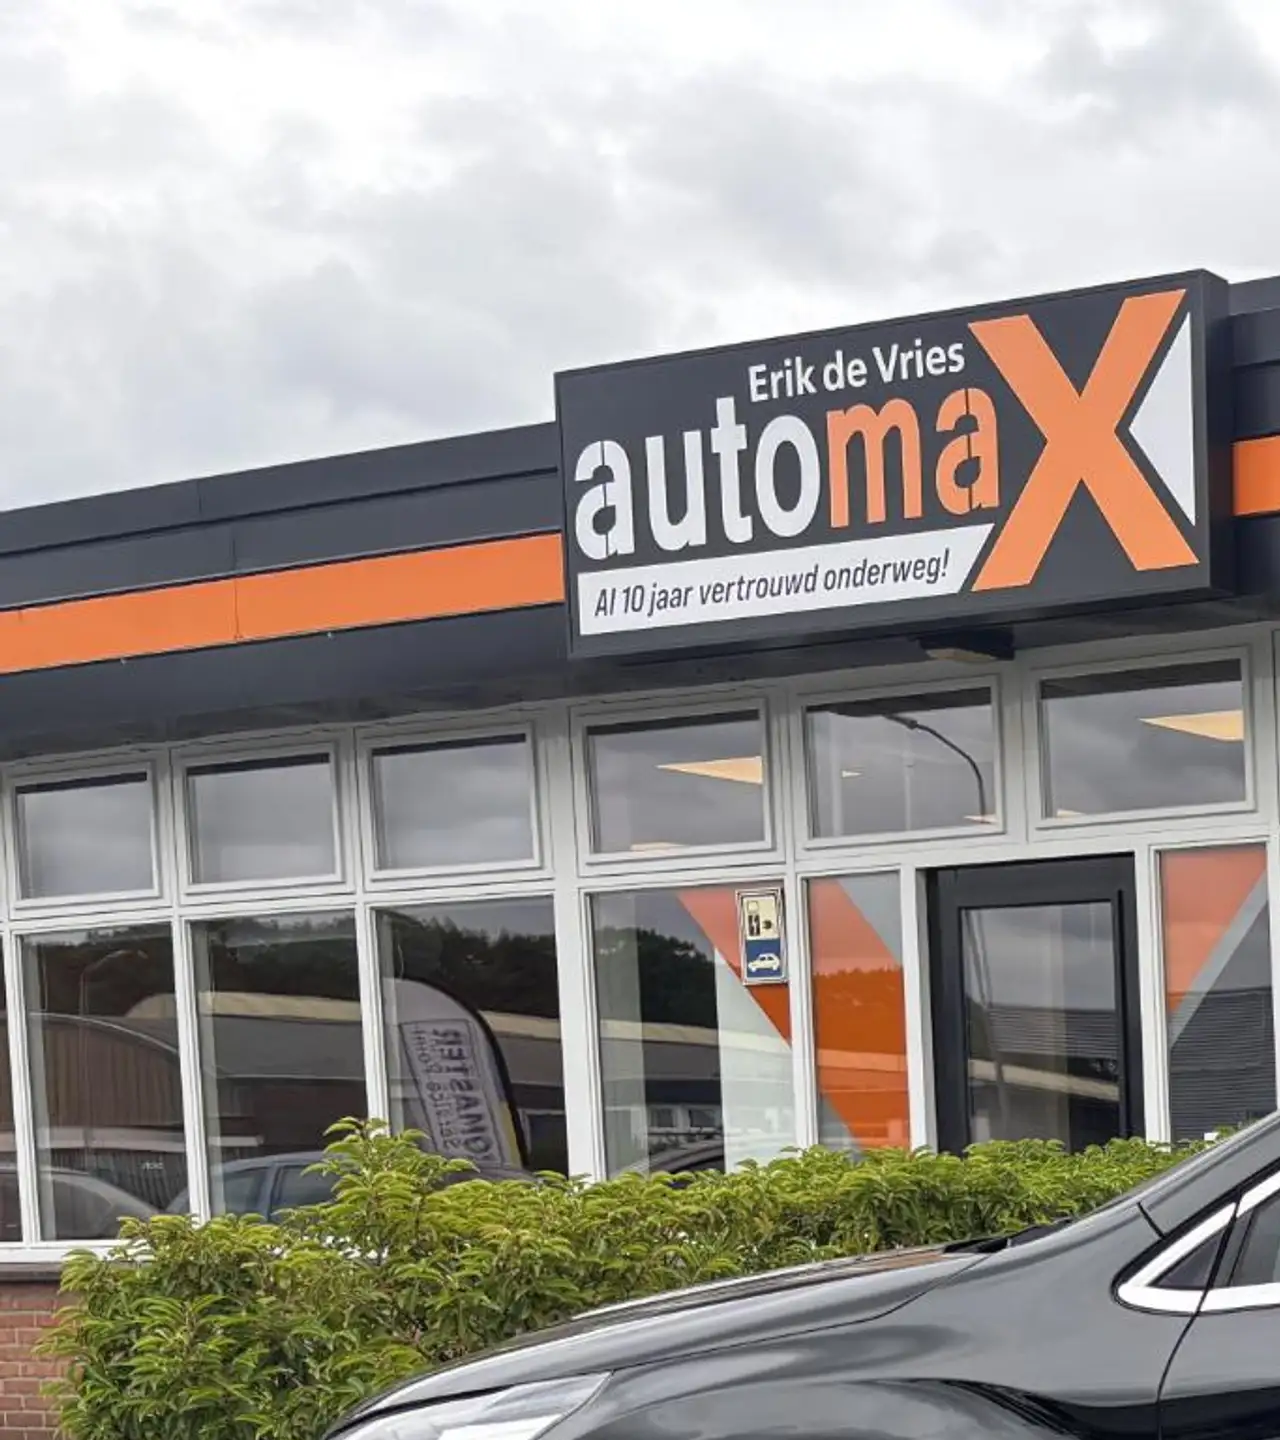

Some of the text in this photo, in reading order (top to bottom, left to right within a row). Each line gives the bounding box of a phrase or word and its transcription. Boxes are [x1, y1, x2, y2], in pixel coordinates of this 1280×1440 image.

[748, 338, 965, 402] Erik de Vries
[594, 547, 950, 617] Al 10 jaar vertrouwd onderweg!
